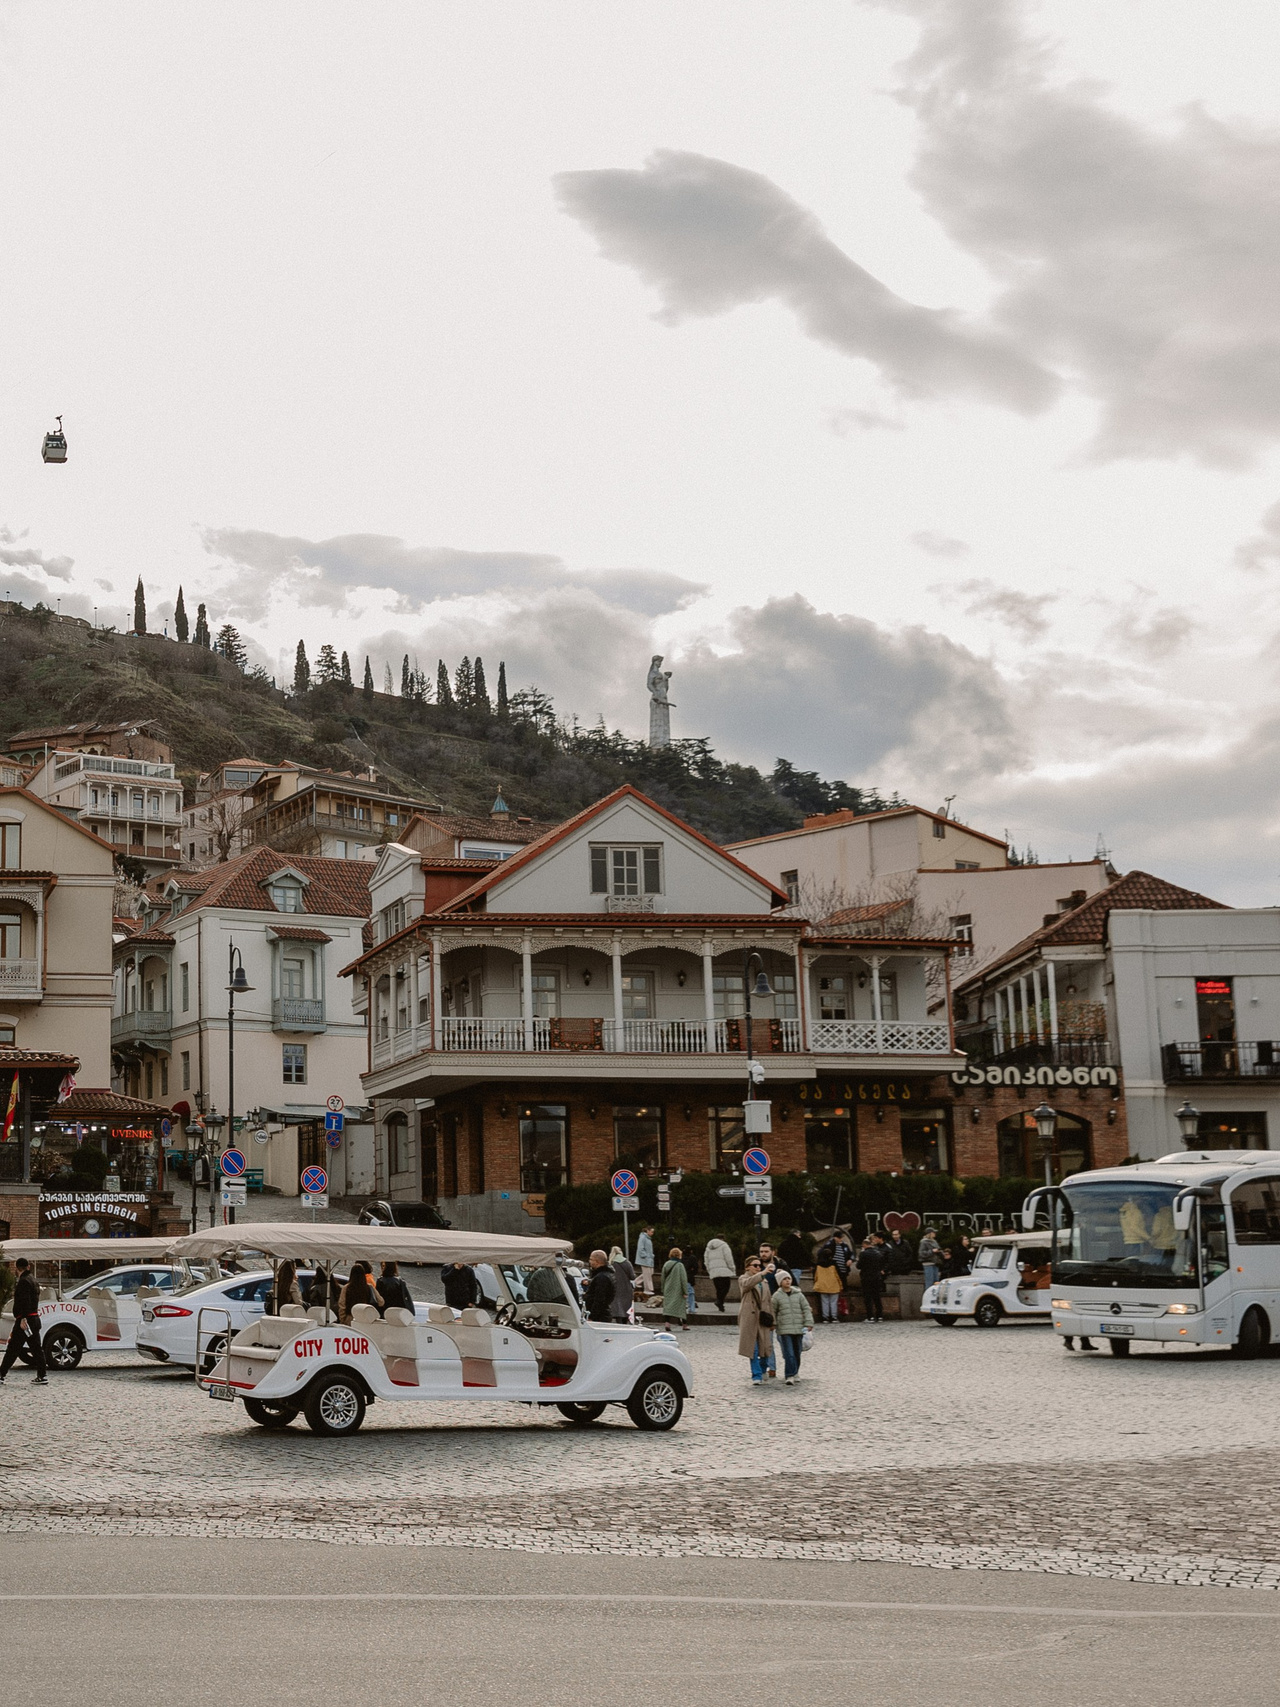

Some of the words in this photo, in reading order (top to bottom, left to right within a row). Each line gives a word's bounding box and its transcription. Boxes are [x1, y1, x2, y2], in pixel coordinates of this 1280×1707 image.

[951, 1066, 1118, 1085] სამიკიტნო
[38, 1193, 73, 1202] ტურები
[45, 1203, 78, 1221] TOURS
[80, 1202, 92, 1212] IN
[94, 1202, 138, 1222] GEORGIA
[37, 1304, 57, 1317] CITY
[59, 1303, 87, 1316] TOUR
[294, 1339, 323, 1358] CITY
[334, 1337, 369, 1355] TOUR
